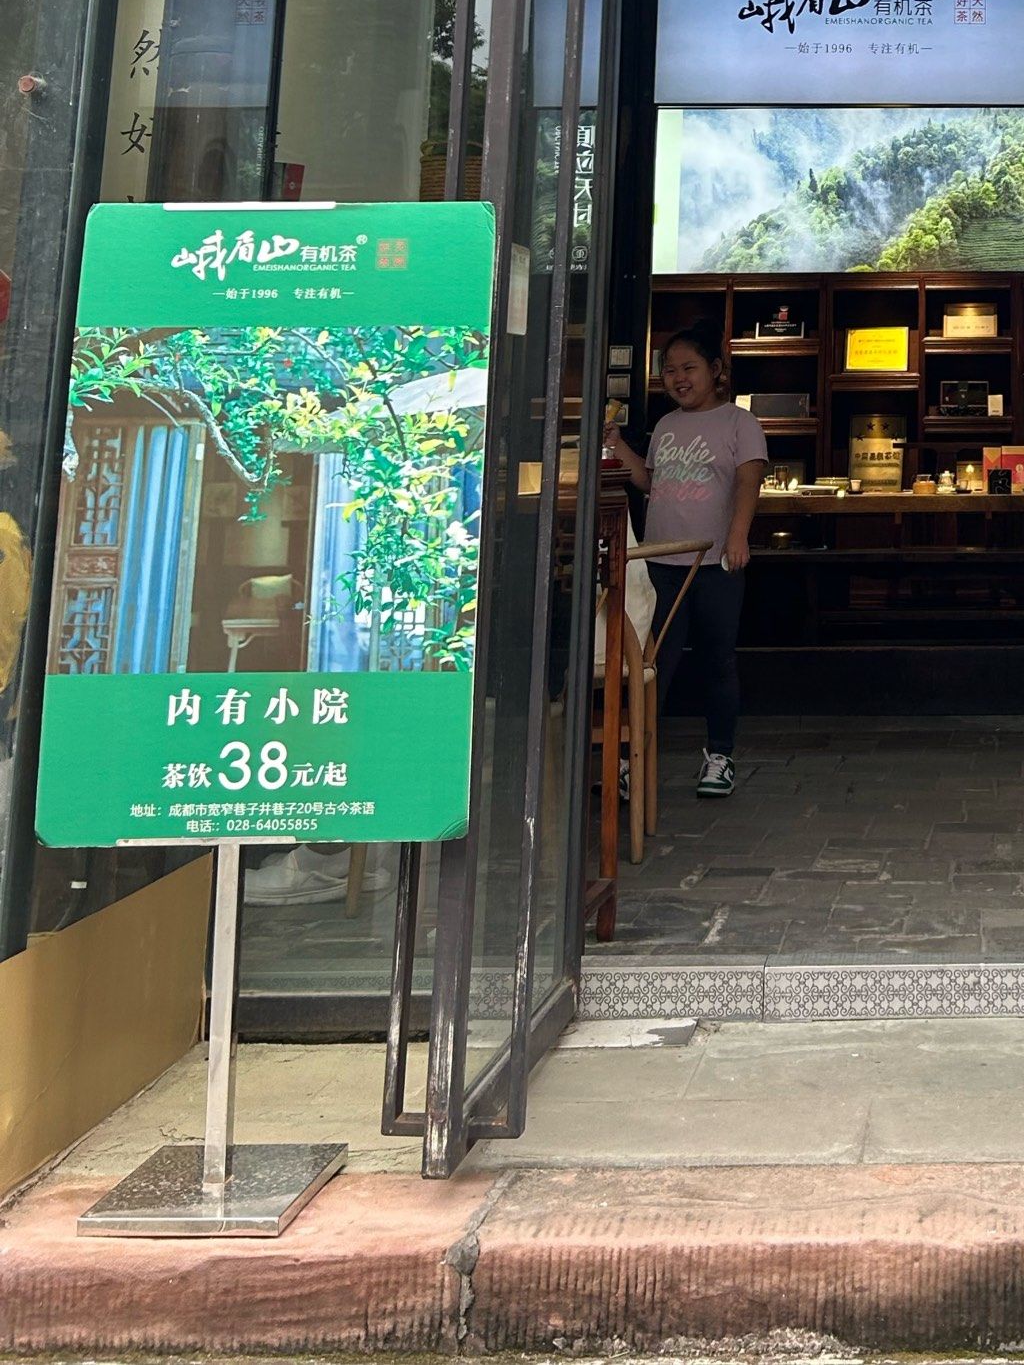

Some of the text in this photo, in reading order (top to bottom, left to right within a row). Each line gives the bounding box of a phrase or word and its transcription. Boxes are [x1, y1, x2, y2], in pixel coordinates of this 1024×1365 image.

[917, 17, 933, 25] TEA
[655, 433, 716, 467] Barbie
[167, 687, 349, 726] 内有小院
